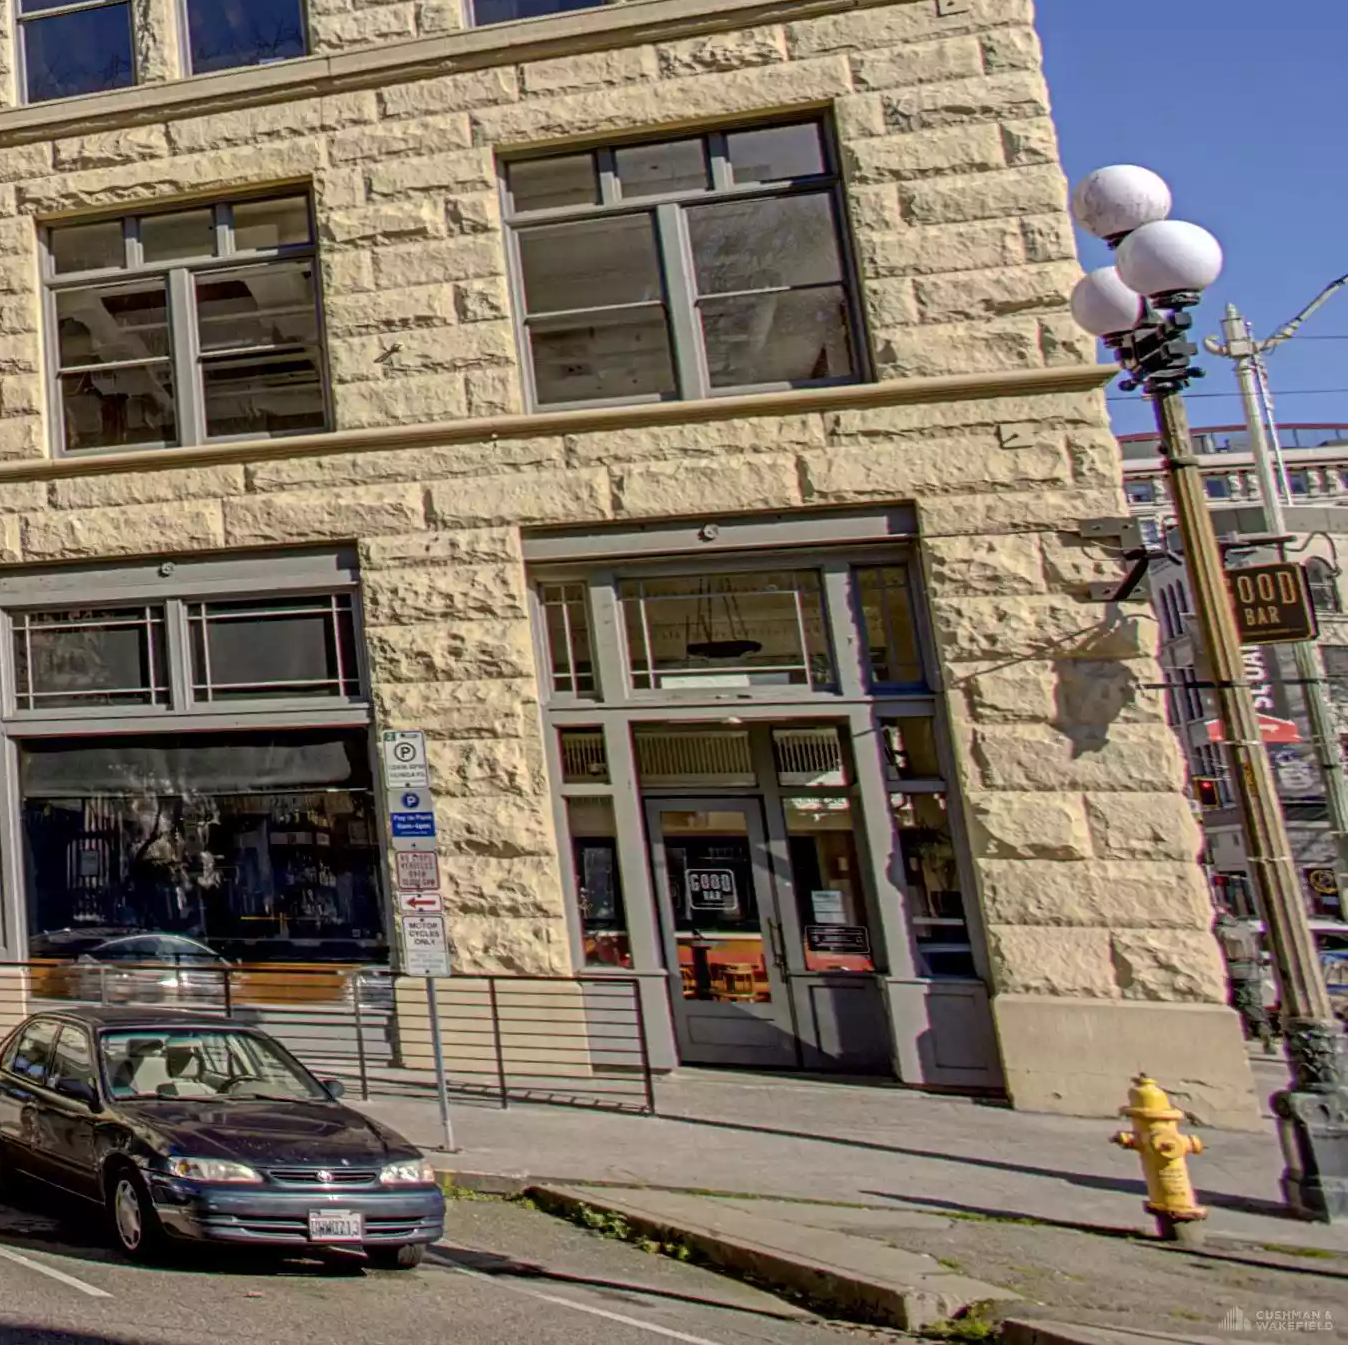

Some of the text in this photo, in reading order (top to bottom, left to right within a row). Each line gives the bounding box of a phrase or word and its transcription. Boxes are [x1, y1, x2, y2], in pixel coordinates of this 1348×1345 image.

[1236, 570, 1297, 604] OOD
[1244, 605, 1281, 626] BAR
[401, 747, 411, 758] P
[689, 874, 731, 892] GOOD
